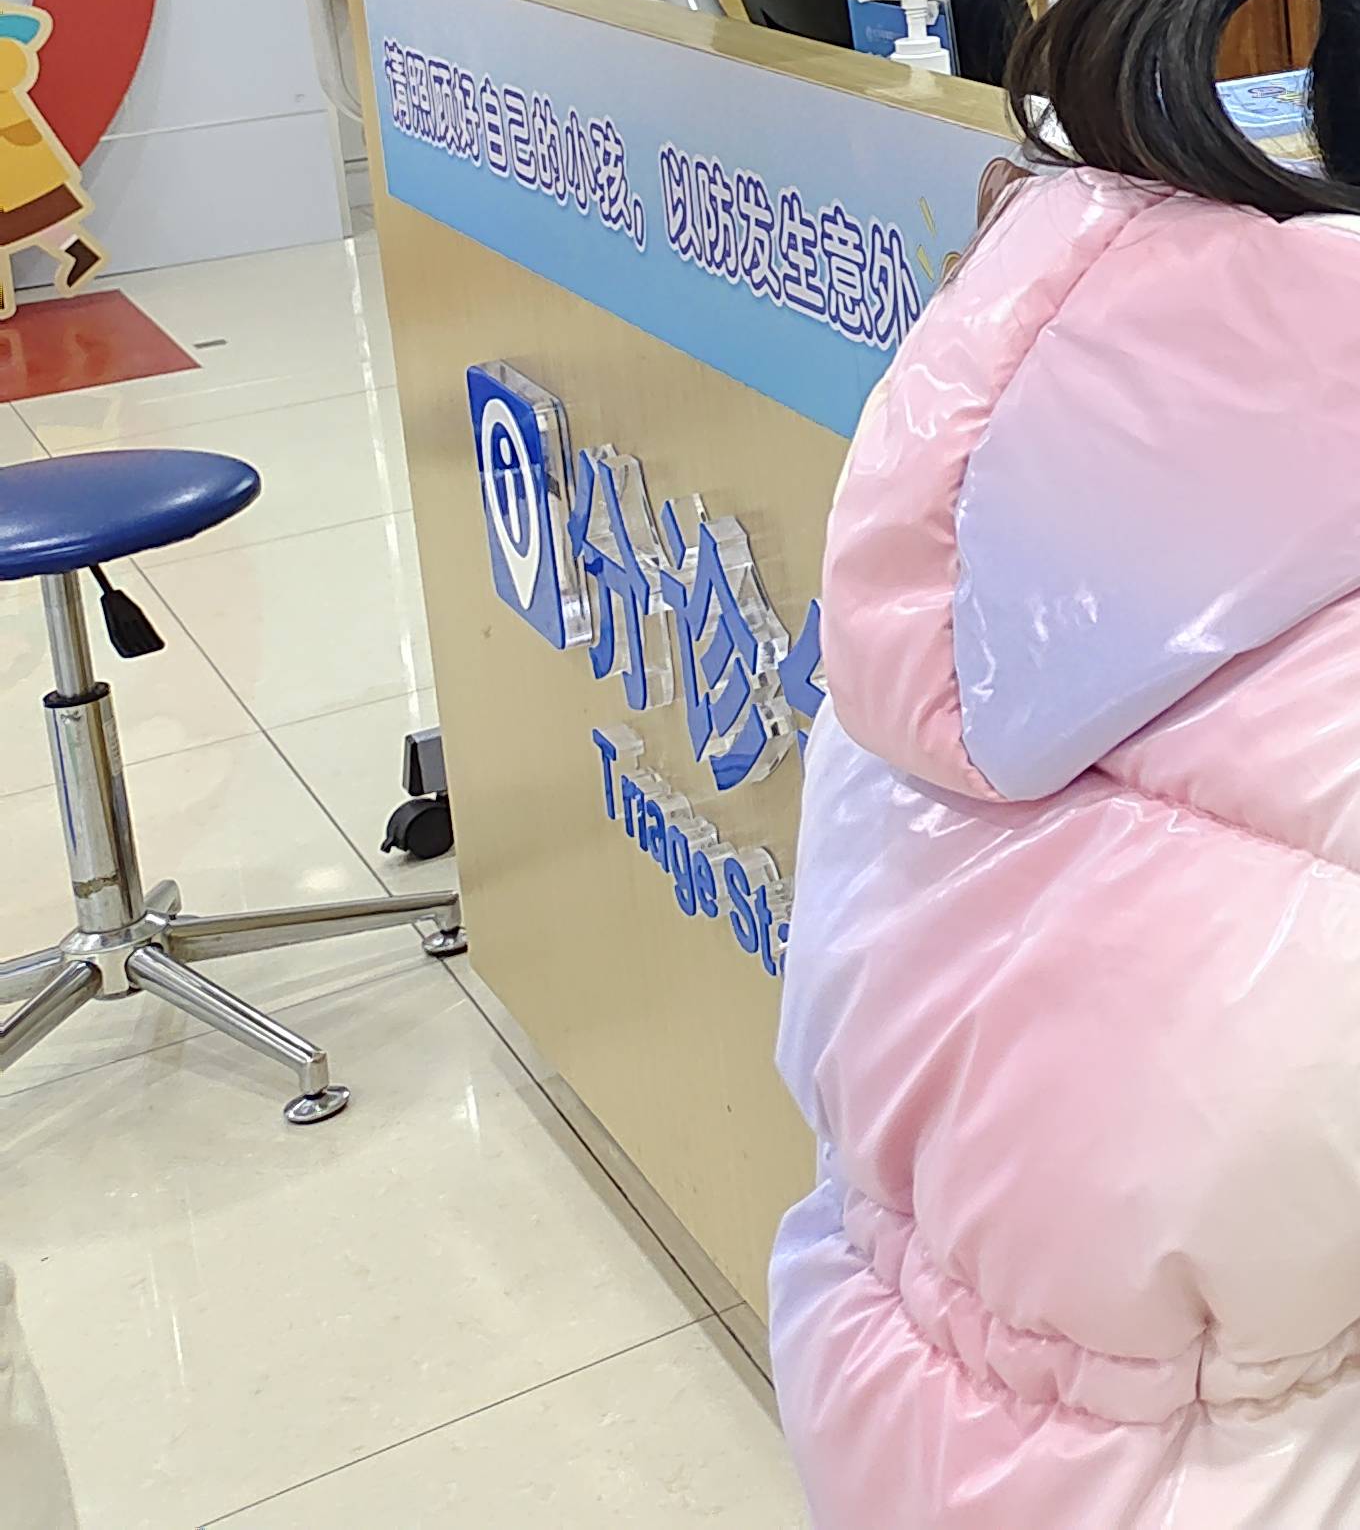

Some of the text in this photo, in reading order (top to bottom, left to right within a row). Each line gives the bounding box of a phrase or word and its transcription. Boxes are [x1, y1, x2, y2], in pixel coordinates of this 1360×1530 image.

[568, 448, 824, 790] 分诊
[593, 728, 790, 977] Triage St
